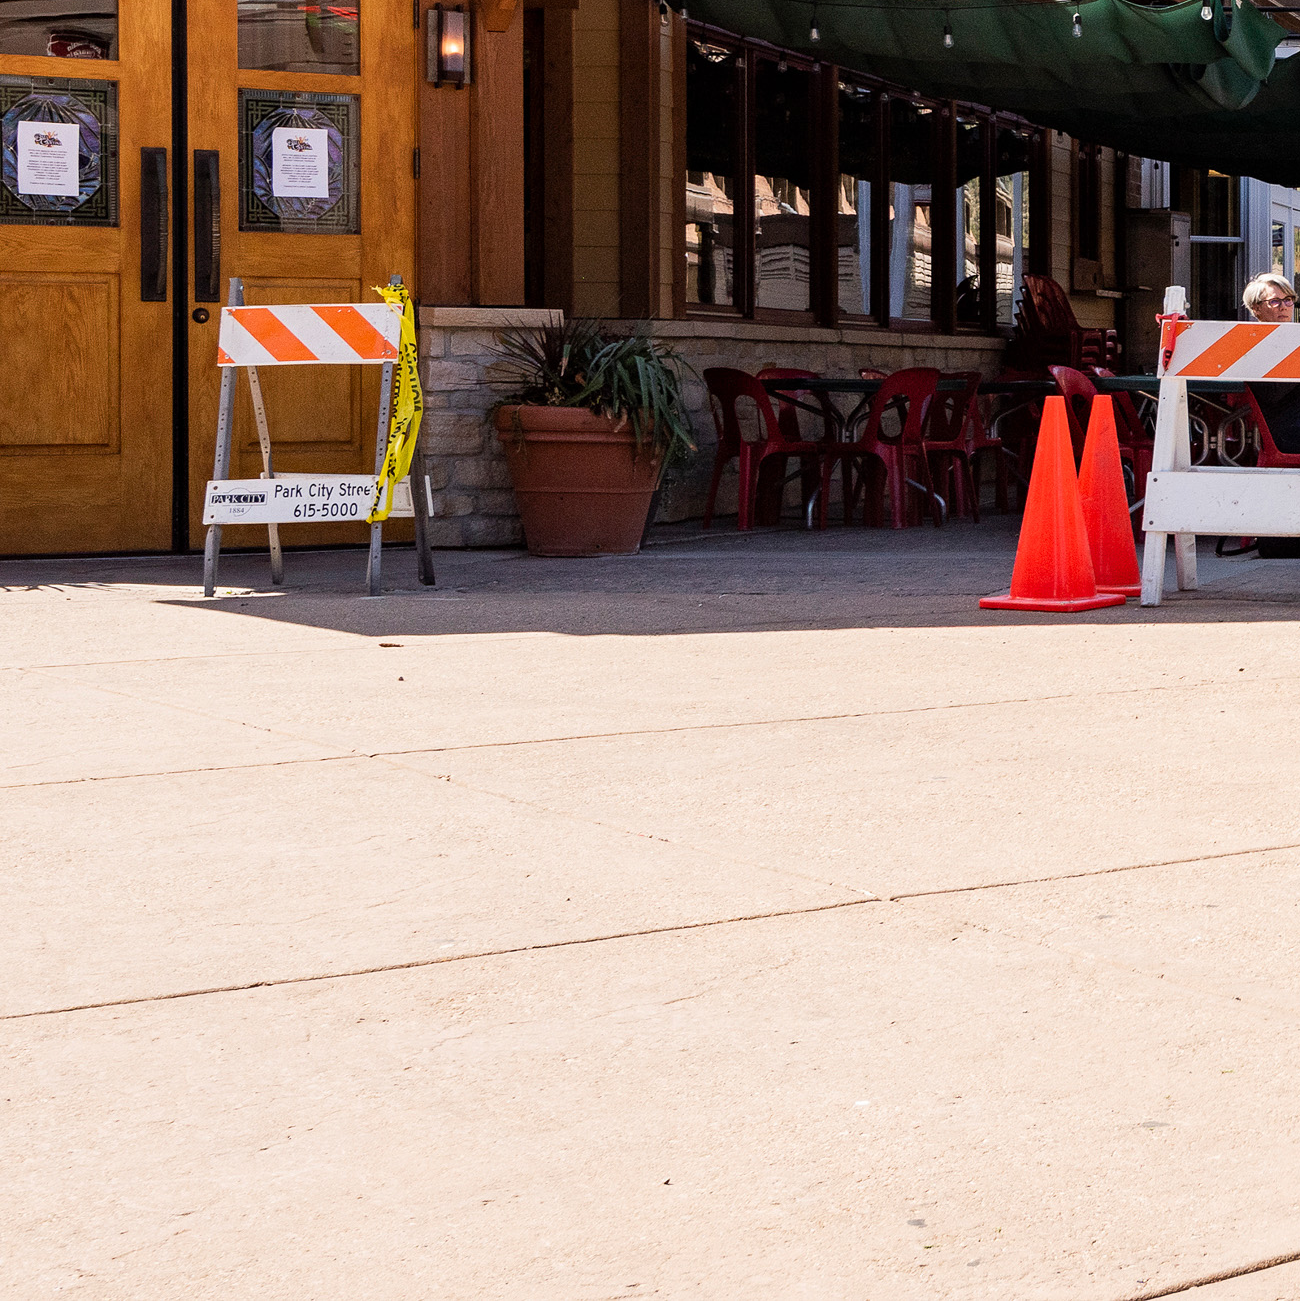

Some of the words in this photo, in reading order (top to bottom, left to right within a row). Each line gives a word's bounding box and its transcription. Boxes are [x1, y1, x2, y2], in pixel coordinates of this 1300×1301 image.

[211, 494, 240, 504] PARK
[240, 494, 265, 504] CITY
[274, 485, 303, 498] Park
[309, 484, 334, 500] City
[293, 503, 358, 518] 615-5000
